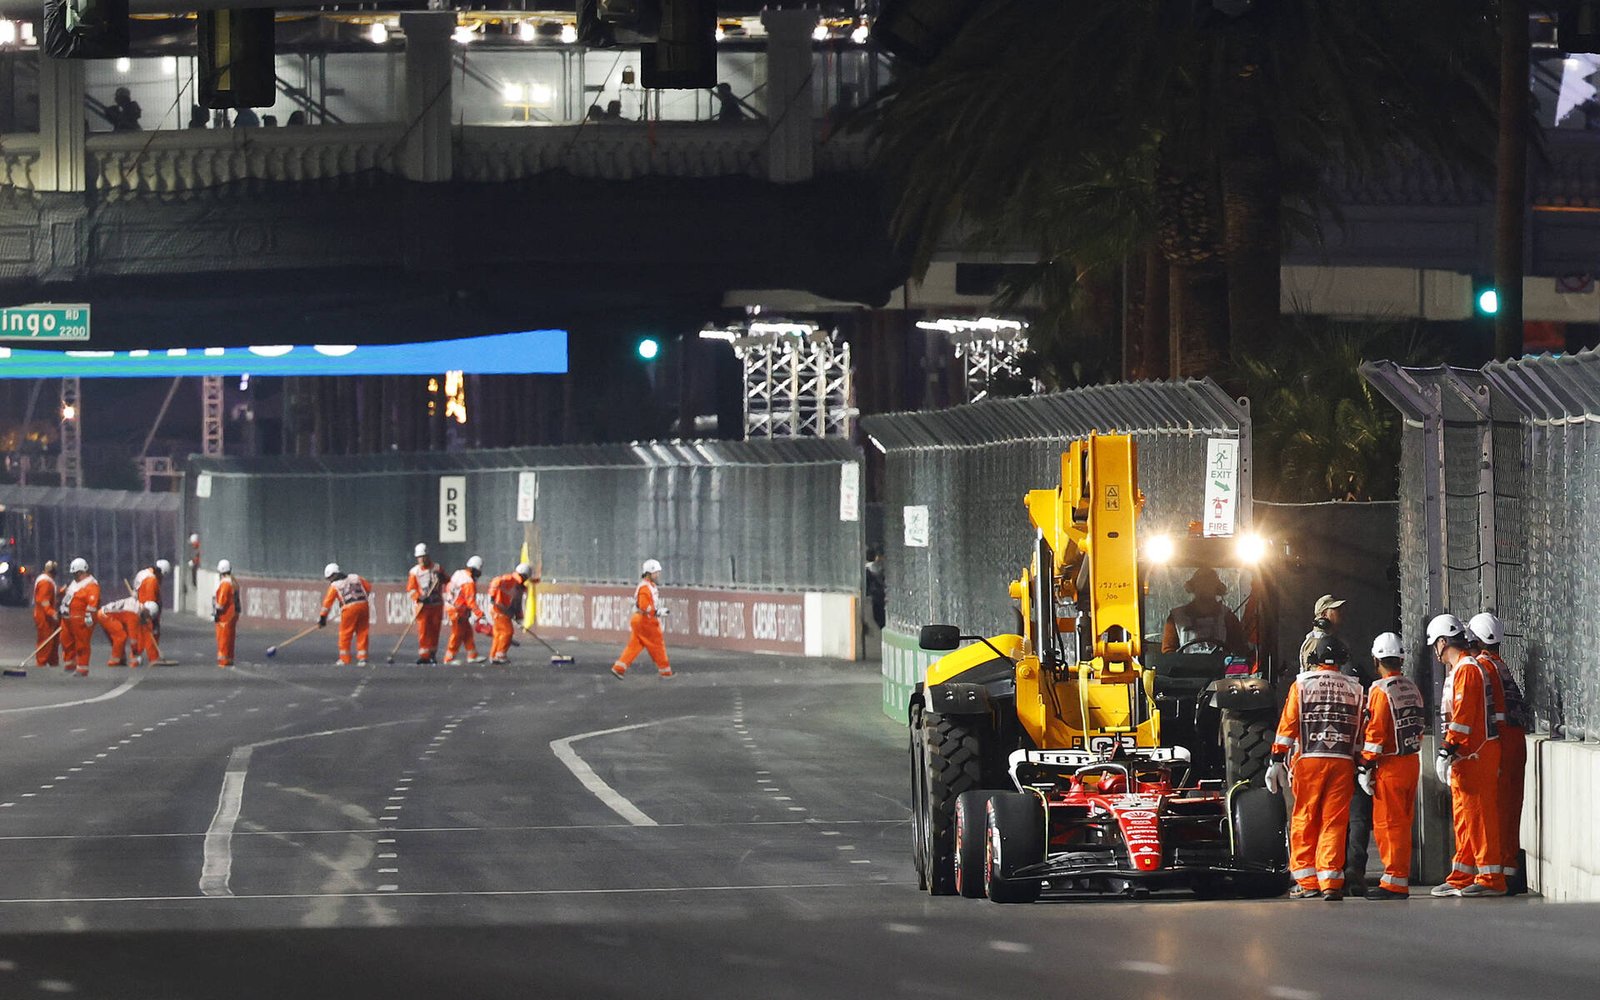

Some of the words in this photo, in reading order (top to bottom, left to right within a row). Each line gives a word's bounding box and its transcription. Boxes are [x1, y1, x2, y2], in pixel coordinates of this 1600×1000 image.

[65, 309, 79, 321] RD
[60, 326, 86, 337] 2200
[1210, 470, 1232, 479] EXIT
[447, 488, 458, 533] DRS
[1208, 522, 1229, 531] FIRE
[1302, 713, 1320, 721] LAS
[1309, 731, 1351, 743] COURSE
